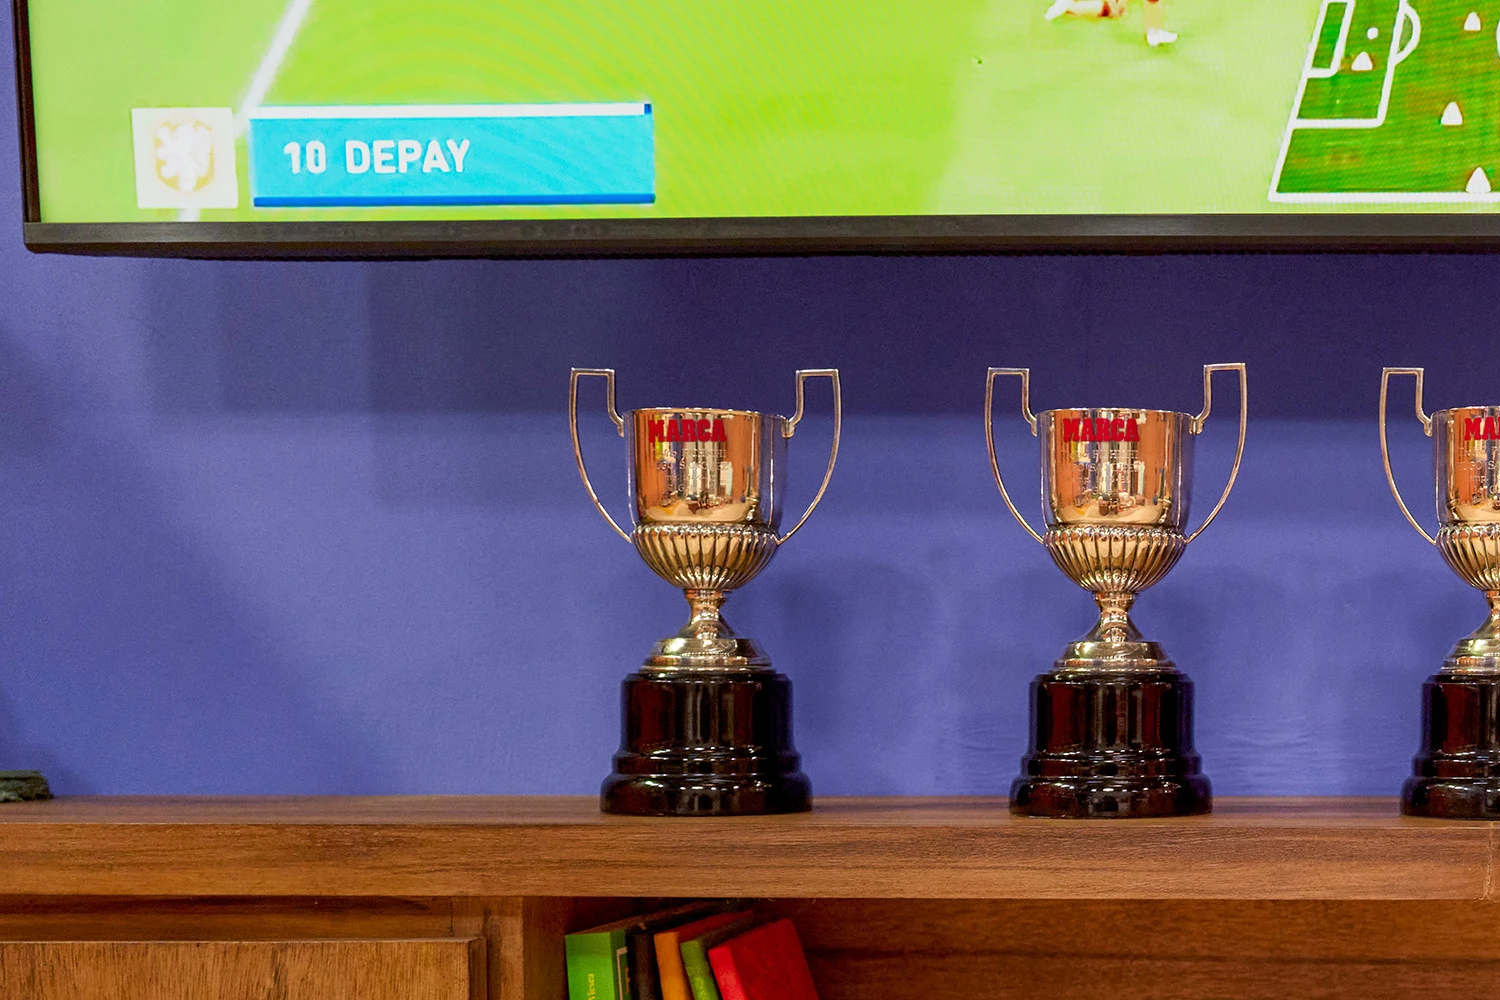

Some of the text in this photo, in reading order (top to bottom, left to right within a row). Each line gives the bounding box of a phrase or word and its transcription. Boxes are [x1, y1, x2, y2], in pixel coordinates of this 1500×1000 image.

[283, 139, 472, 175] 10 DEPAY
[648, 418, 728, 443] MARCA
[1063, 417, 1141, 443] MARCA
